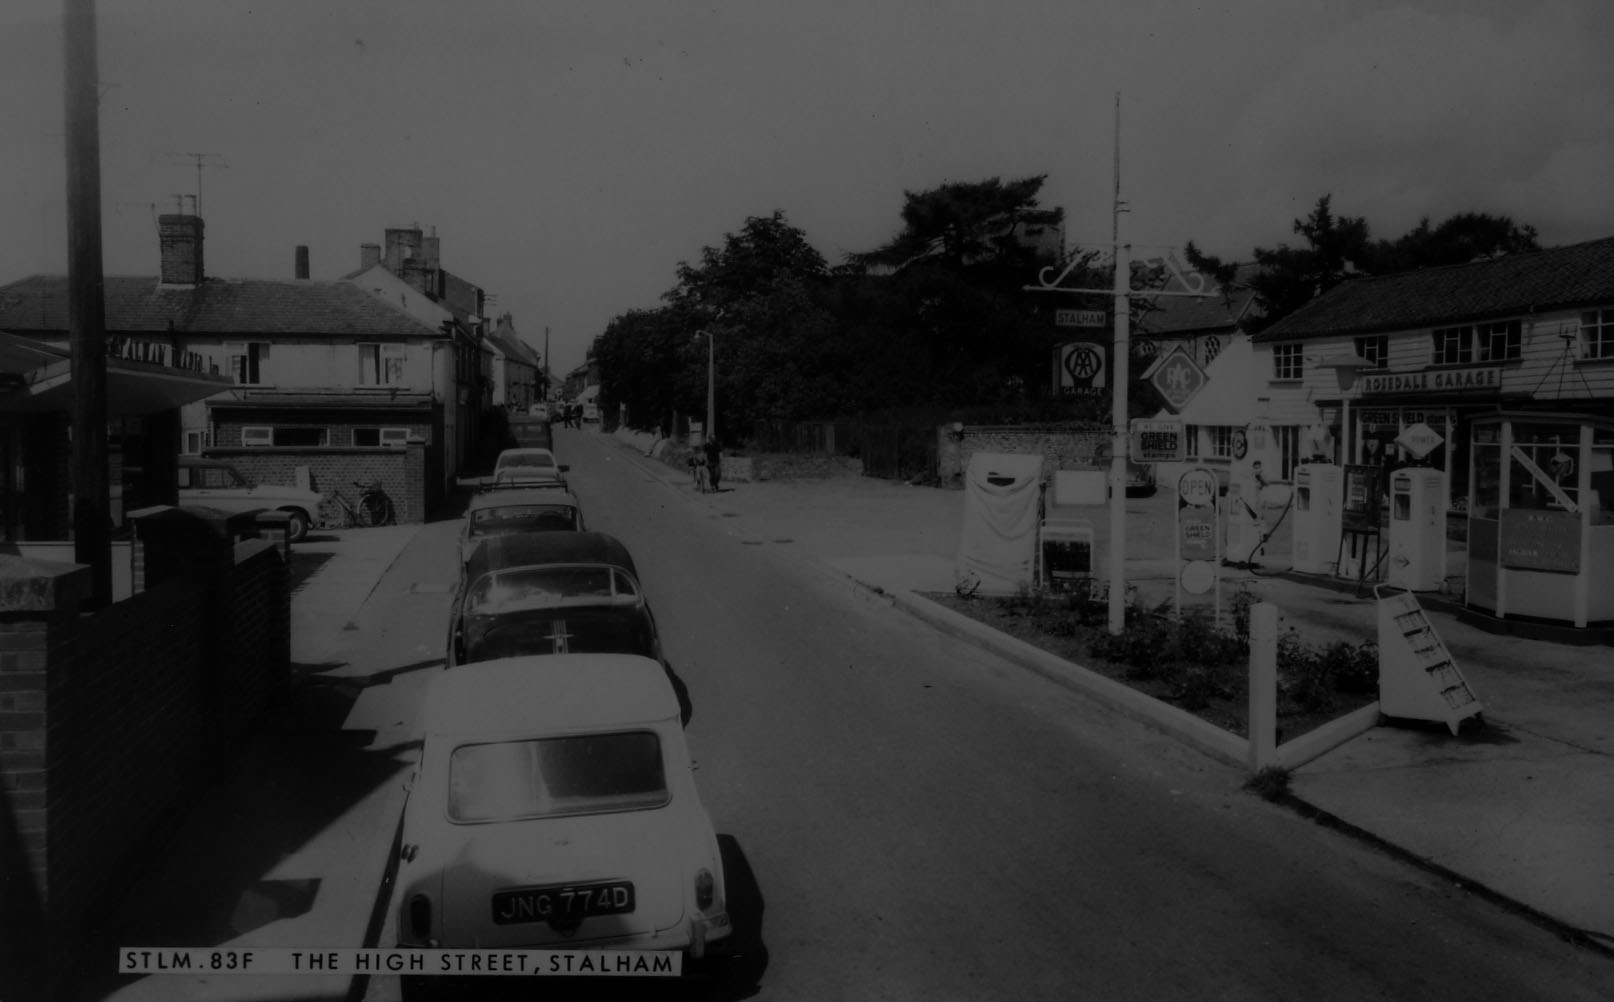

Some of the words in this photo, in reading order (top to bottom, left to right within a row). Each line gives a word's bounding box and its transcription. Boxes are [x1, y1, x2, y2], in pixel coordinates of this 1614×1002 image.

[1057, 312, 1104, 325] STALHAM
[1365, 374, 1427, 391] ROSEDALE
[1435, 370, 1495, 387] GARAGE
[1062, 386, 1103, 397] GARAGE
[1361, 412, 1390, 424] GREEN
[1141, 431, 1178, 441] GREEN
[1141, 440, 1178, 451] SHIELD
[1143, 452, 1176, 460] stamps
[1182, 480, 1212, 496] OPEN
[500, 894, 552, 919] JNG
[560, 886, 629, 913] 774D
